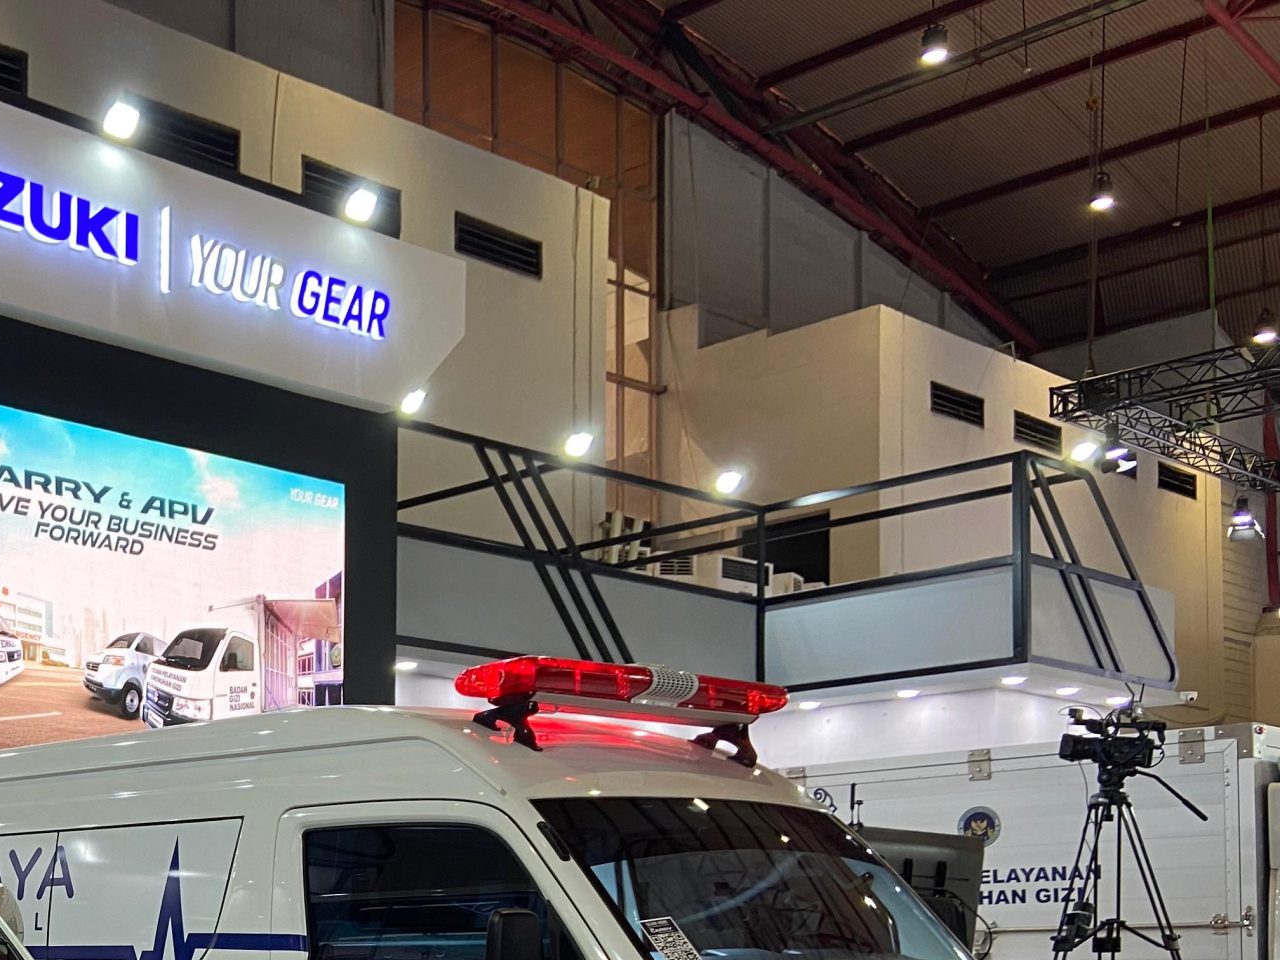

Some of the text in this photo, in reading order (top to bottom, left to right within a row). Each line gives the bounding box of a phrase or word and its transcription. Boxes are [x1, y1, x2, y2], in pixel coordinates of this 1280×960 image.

[190, 233, 285, 311] YOUR
[293, 269, 392, 342] GEAR
[118, 491, 133, 510] &
[140, 495, 216, 526] APV
[290, 487, 339, 510] YOUR GEAR
[34, 521, 145, 556] FORWARD
[38, 500, 103, 530] YOUR
[107, 514, 219, 551] BUSINESS
